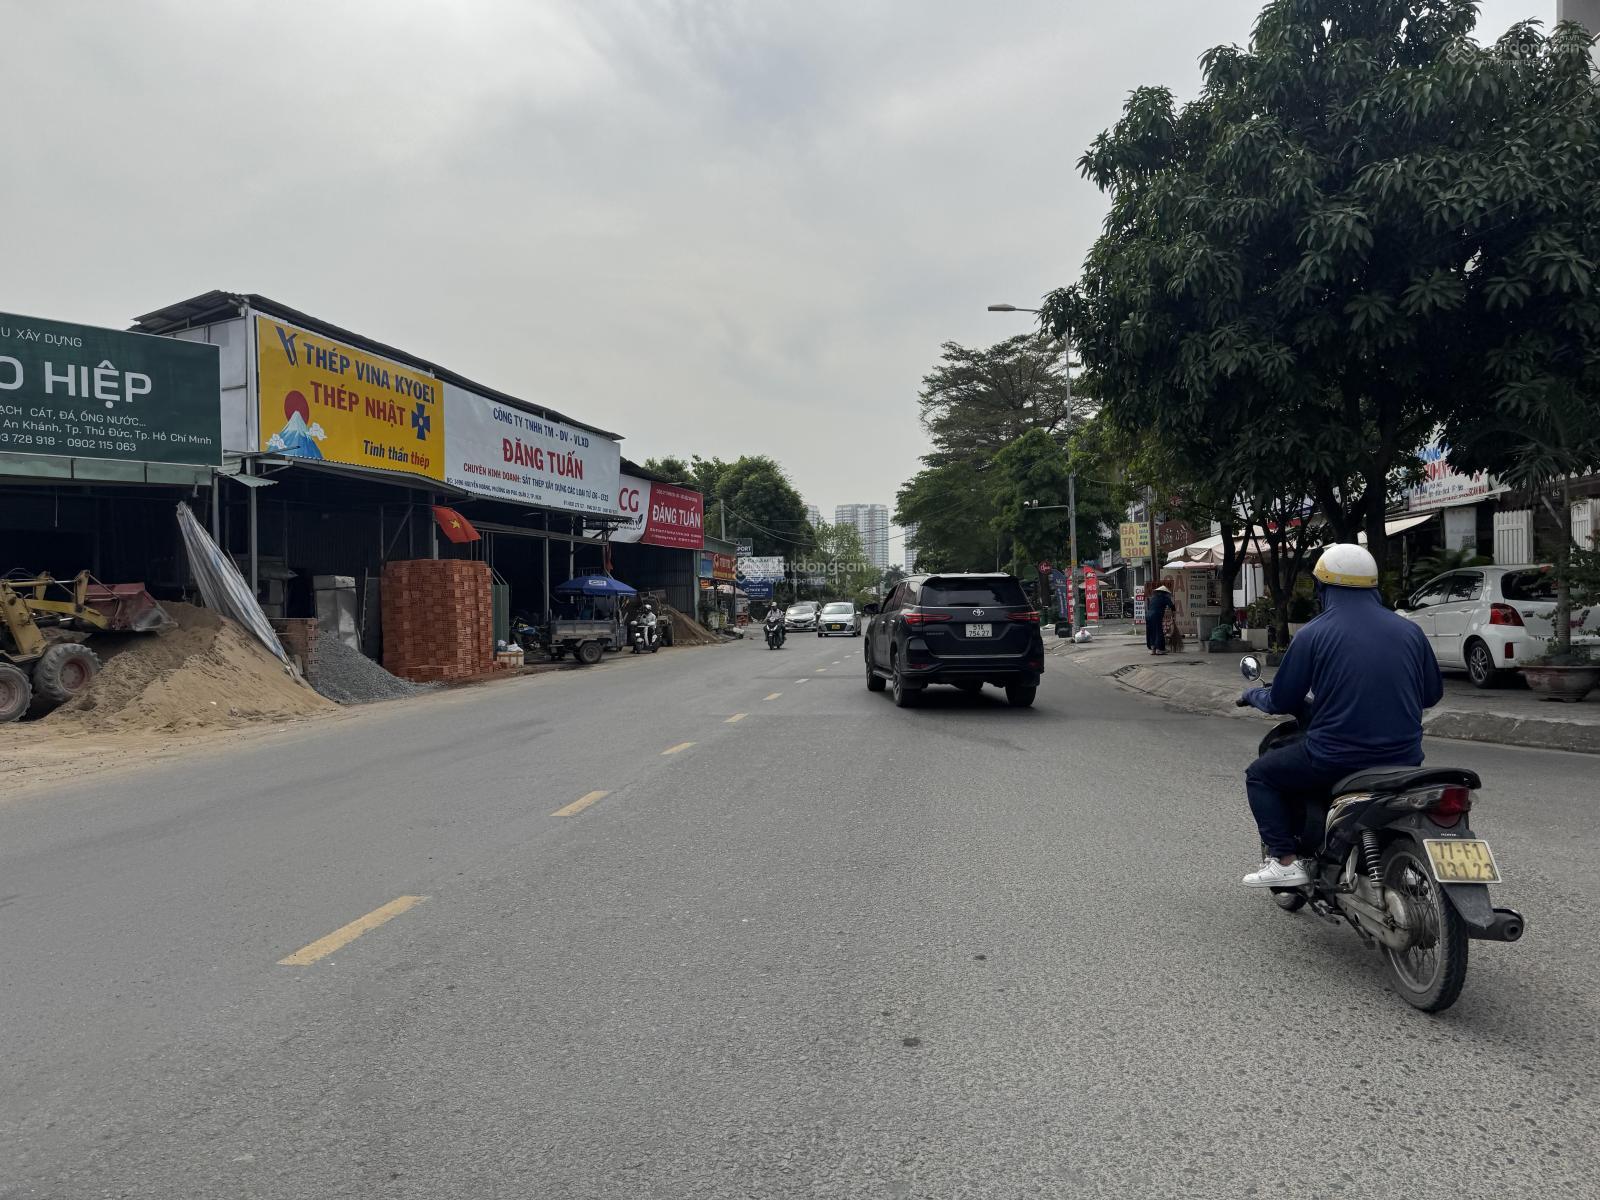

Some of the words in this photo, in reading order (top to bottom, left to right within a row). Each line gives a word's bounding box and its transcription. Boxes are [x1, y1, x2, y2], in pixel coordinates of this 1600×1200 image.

[16, 328, 41, 342] XÂY
[45, 333, 82, 348] DỰNG
[44, 359, 152, 409] HIỆP
[303, 342, 350, 375] THÉP
[354, 359, 391, 391] VINA
[395, 376, 435, 405] KYOEI
[30, 406, 56, 420] CÁT,
[59, 409, 78, 421] ĐÁ,
[80, 409, 104, 423] ỐNG
[106, 414, 146, 427] NƯỚC...
[310, 380, 360, 413] THÉP
[365, 395, 406, 428] NHẬT
[3, 419, 19, 429] An
[22, 420, 62, 433] Khánh,
[65, 424, 82, 436] Tp.
[84, 425, 105, 436] Thủ
[108, 426, 132, 438] Đức,
[135, 430, 150, 441] Tp.
[152, 431, 167, 441] Hồ
[170, 432, 186, 443] Chí
[188, 435, 212, 445] Minh
[493, 407, 513, 425] CÔNG
[514, 415, 523, 428] TY
[524, 418, 543, 435] TNHH
[544, 425, 554, 439] TM
[574, 434, 589, 448] VLXD
[12, 433, 33, 444] 728
[36, 436, 55, 446] 918
[67, 438, 96, 449] 0902
[98, 440, 113, 450] 115
[116, 442, 137, 452] 063
[363, 439, 385, 459] Tinh
[410, 451, 430, 470] thép
[502, 437, 544, 472] ĐĂNG
[547, 450, 583, 481] TUẤN
[463, 462, 487, 476] CHUYÊN
[532, 476, 545, 488] THÉP
[652, 501, 677, 524] ĐĂNG
[678, 506, 701, 529] TUẤN
[1121, 536, 1135, 547] TA
